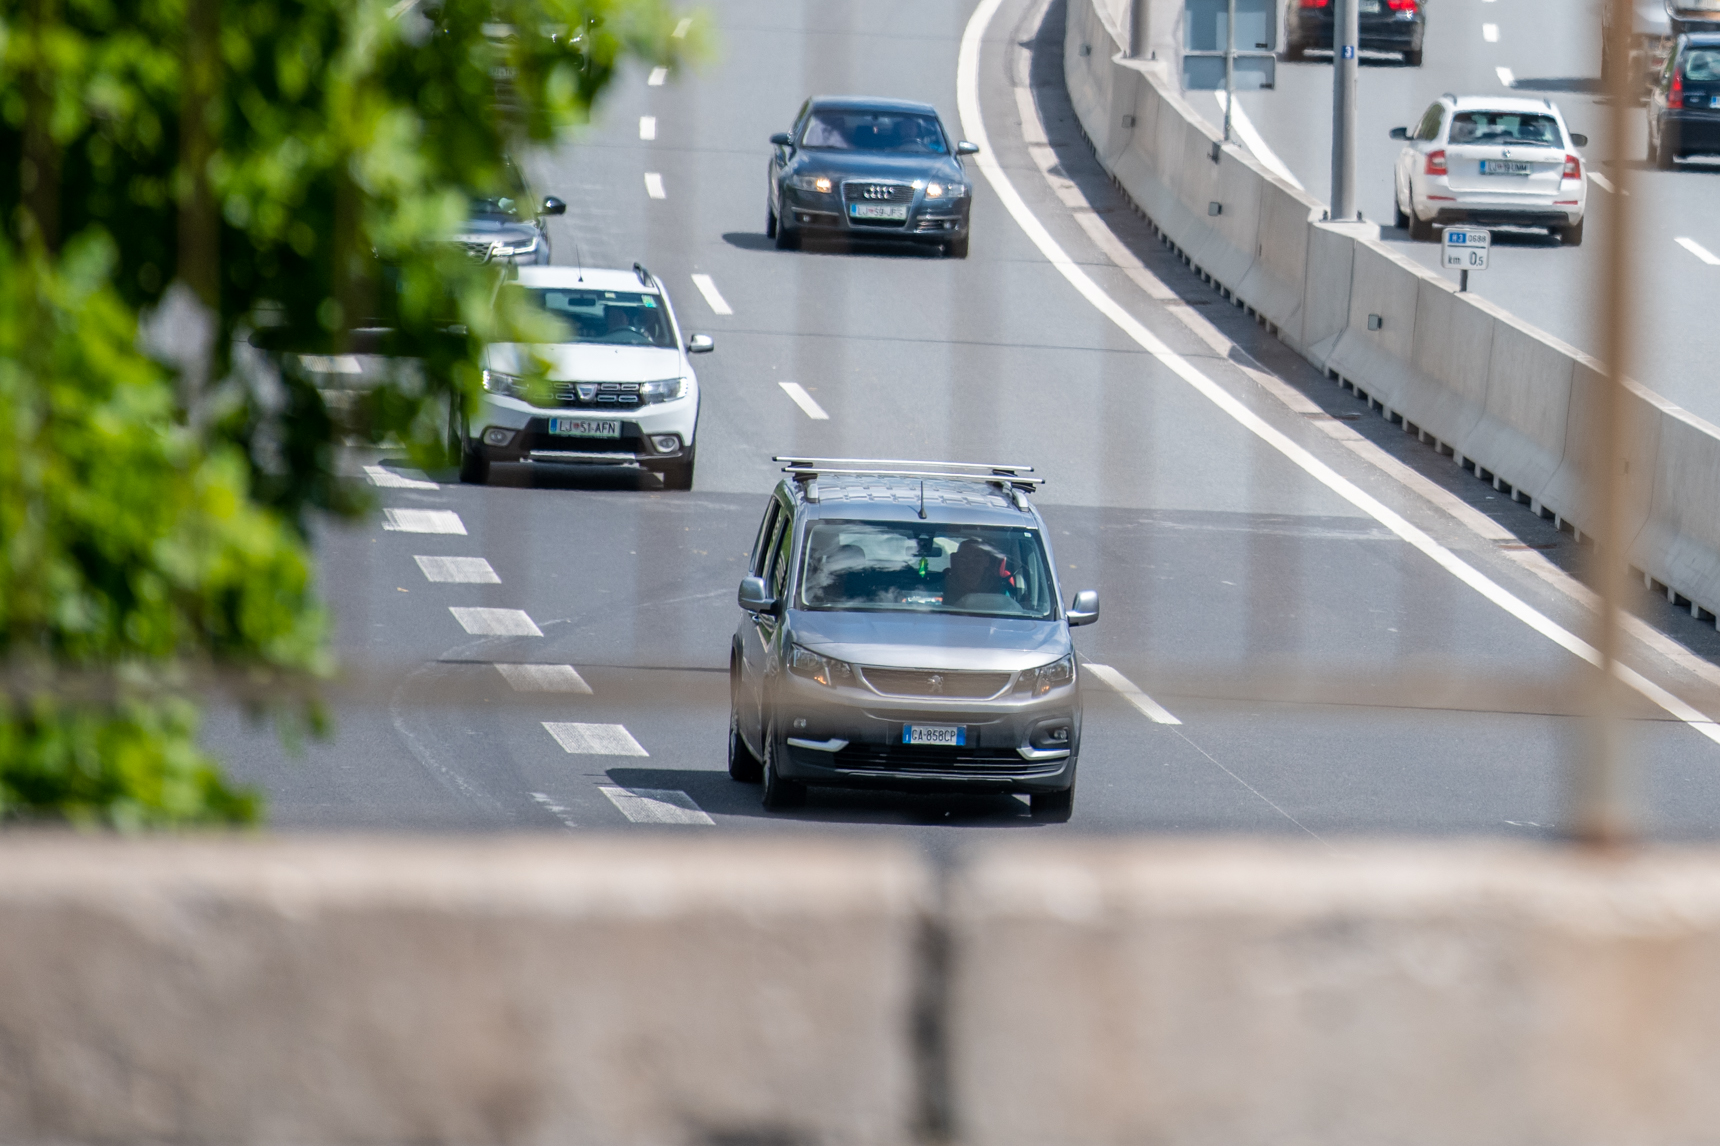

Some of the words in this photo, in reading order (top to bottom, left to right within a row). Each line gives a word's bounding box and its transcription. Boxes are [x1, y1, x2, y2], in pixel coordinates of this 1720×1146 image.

[1344, 46, 1352, 58] 3
[1467, 235, 1487, 243] 0688
[1447, 254, 1462, 265] km
[1469, 251, 1484, 267] 0,5
